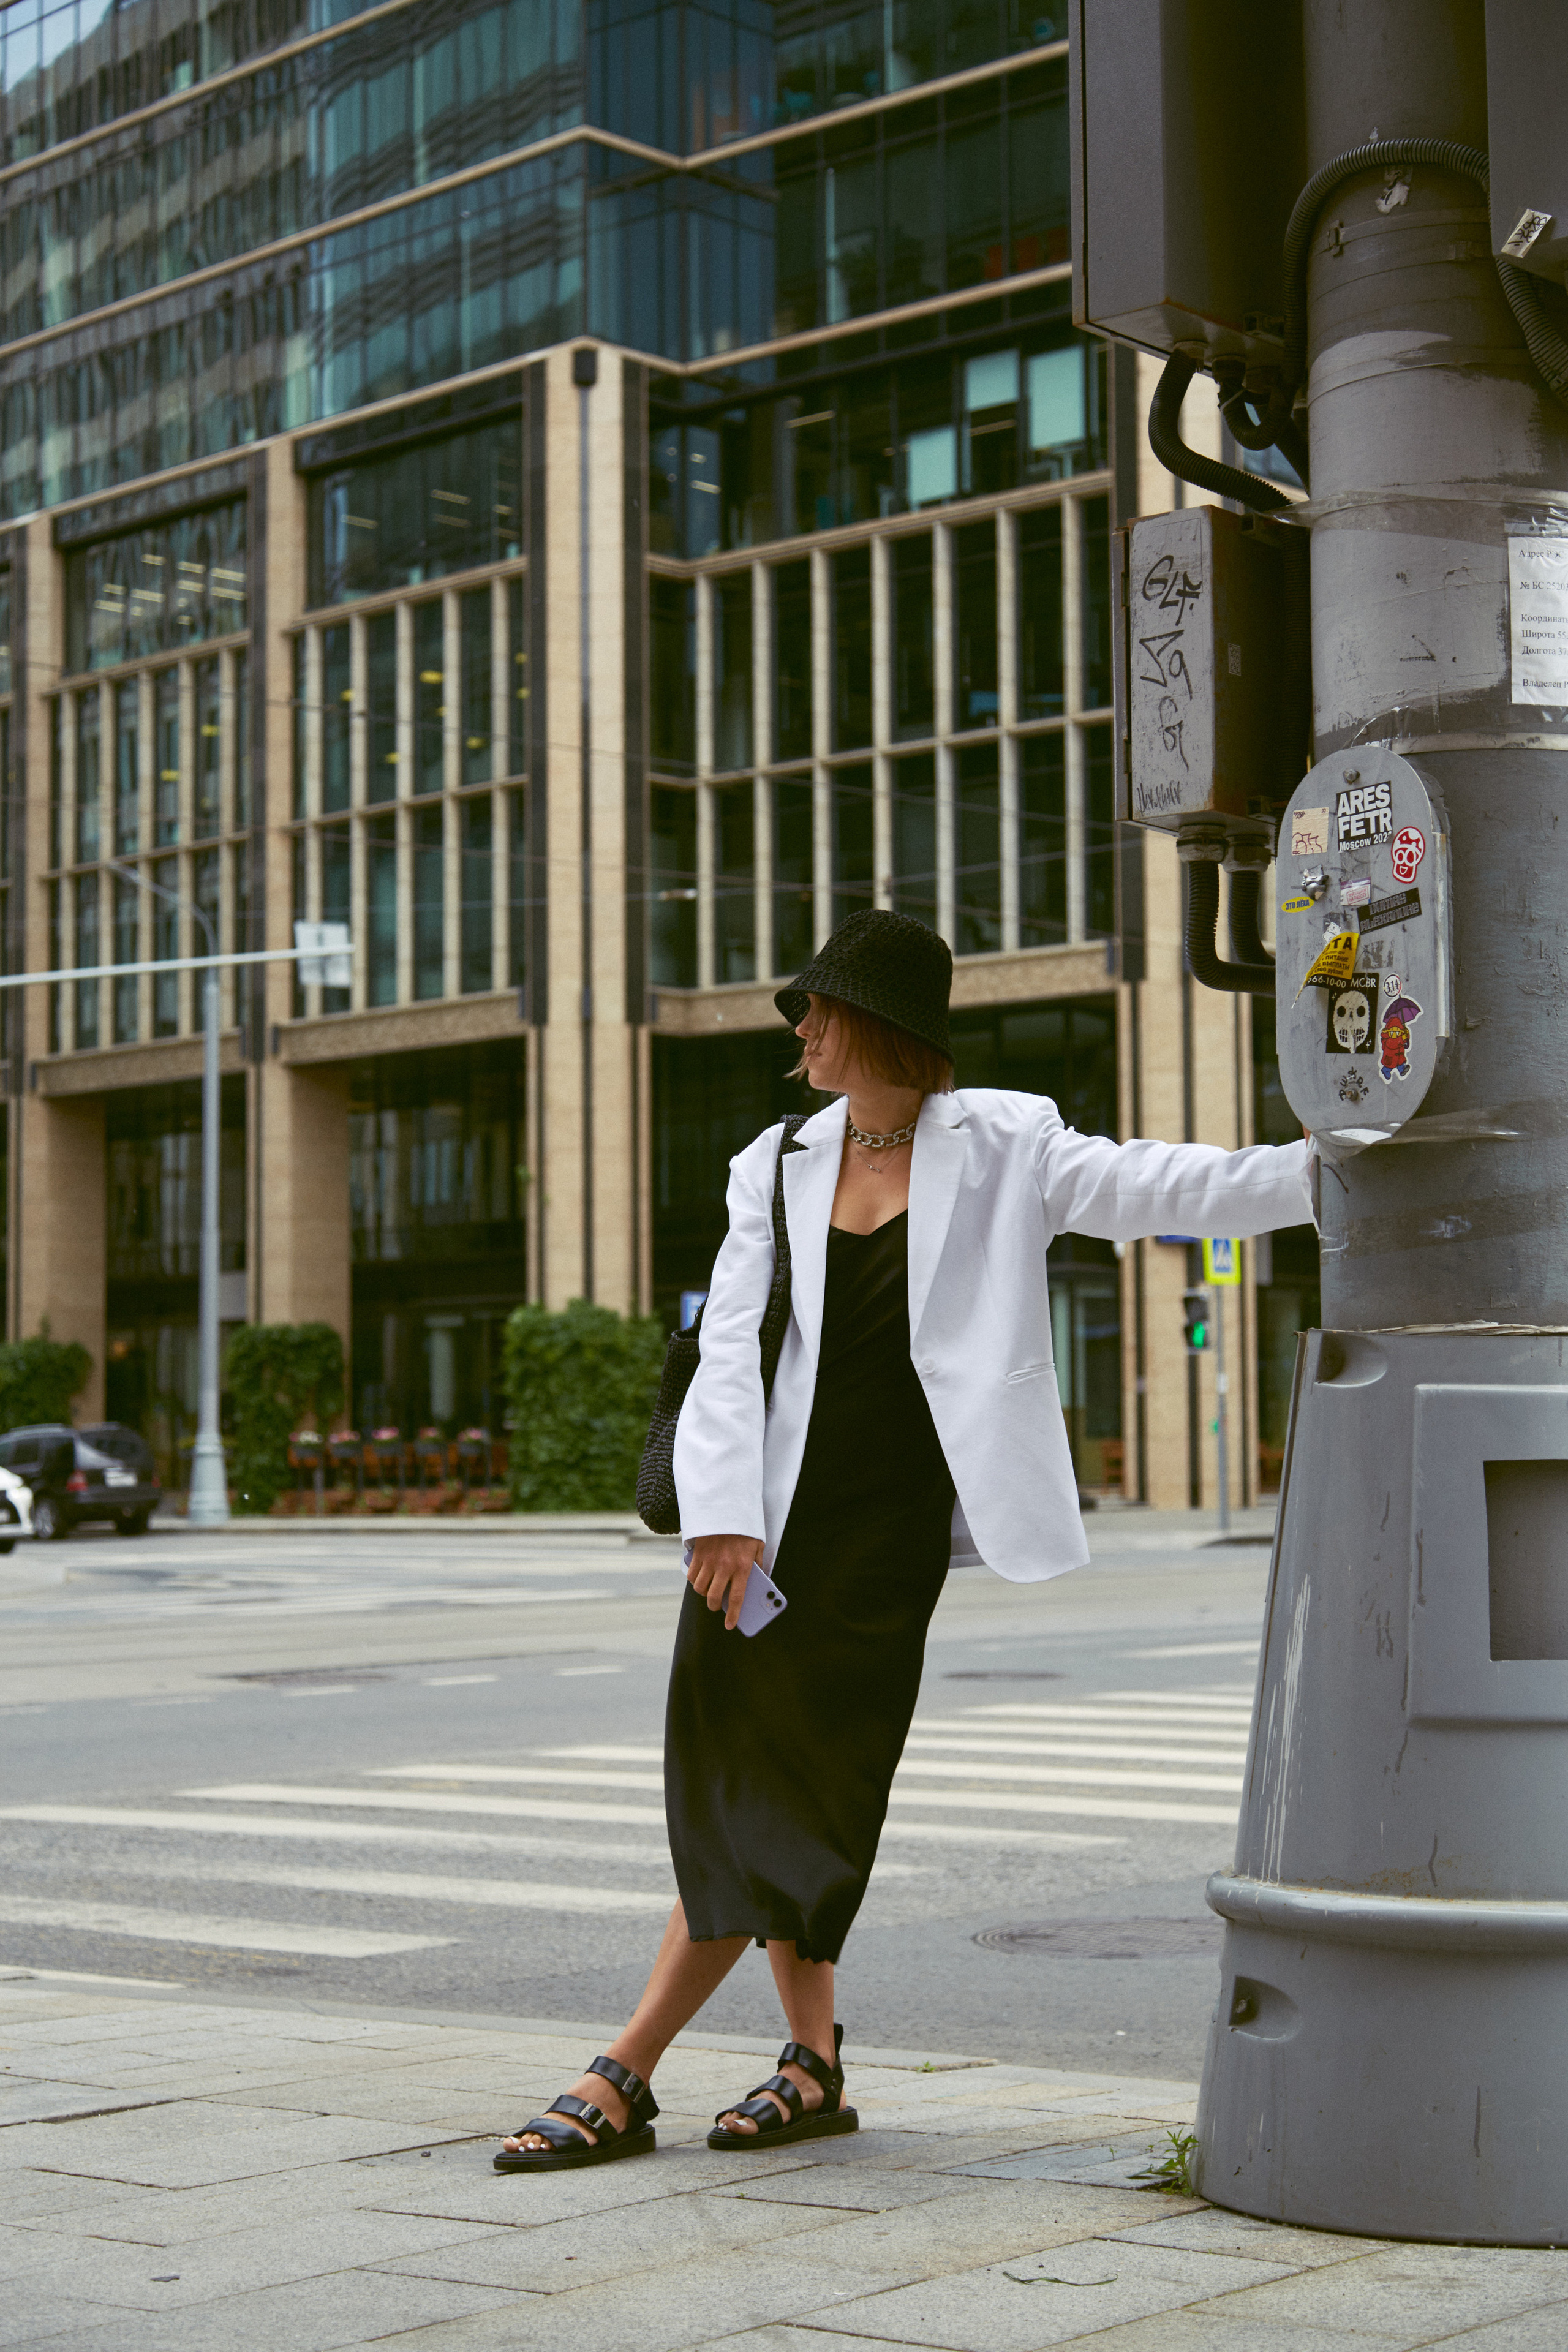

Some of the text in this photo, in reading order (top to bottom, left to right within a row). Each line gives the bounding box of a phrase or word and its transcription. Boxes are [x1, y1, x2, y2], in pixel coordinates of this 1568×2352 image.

[1522, 630, 1555, 639] Широта
[1522, 646, 1556, 655] Долгота
[1523, 679, 1562, 688] Владелец
[1337, 783, 1390, 818] ARES
[1338, 807, 1392, 840] FETR
[1322, 961, 1350, 970] ВЫПЛАТЫ
[1350, 978, 1377, 988] MCBR
[1386, 979, 1399, 993] 3.14
